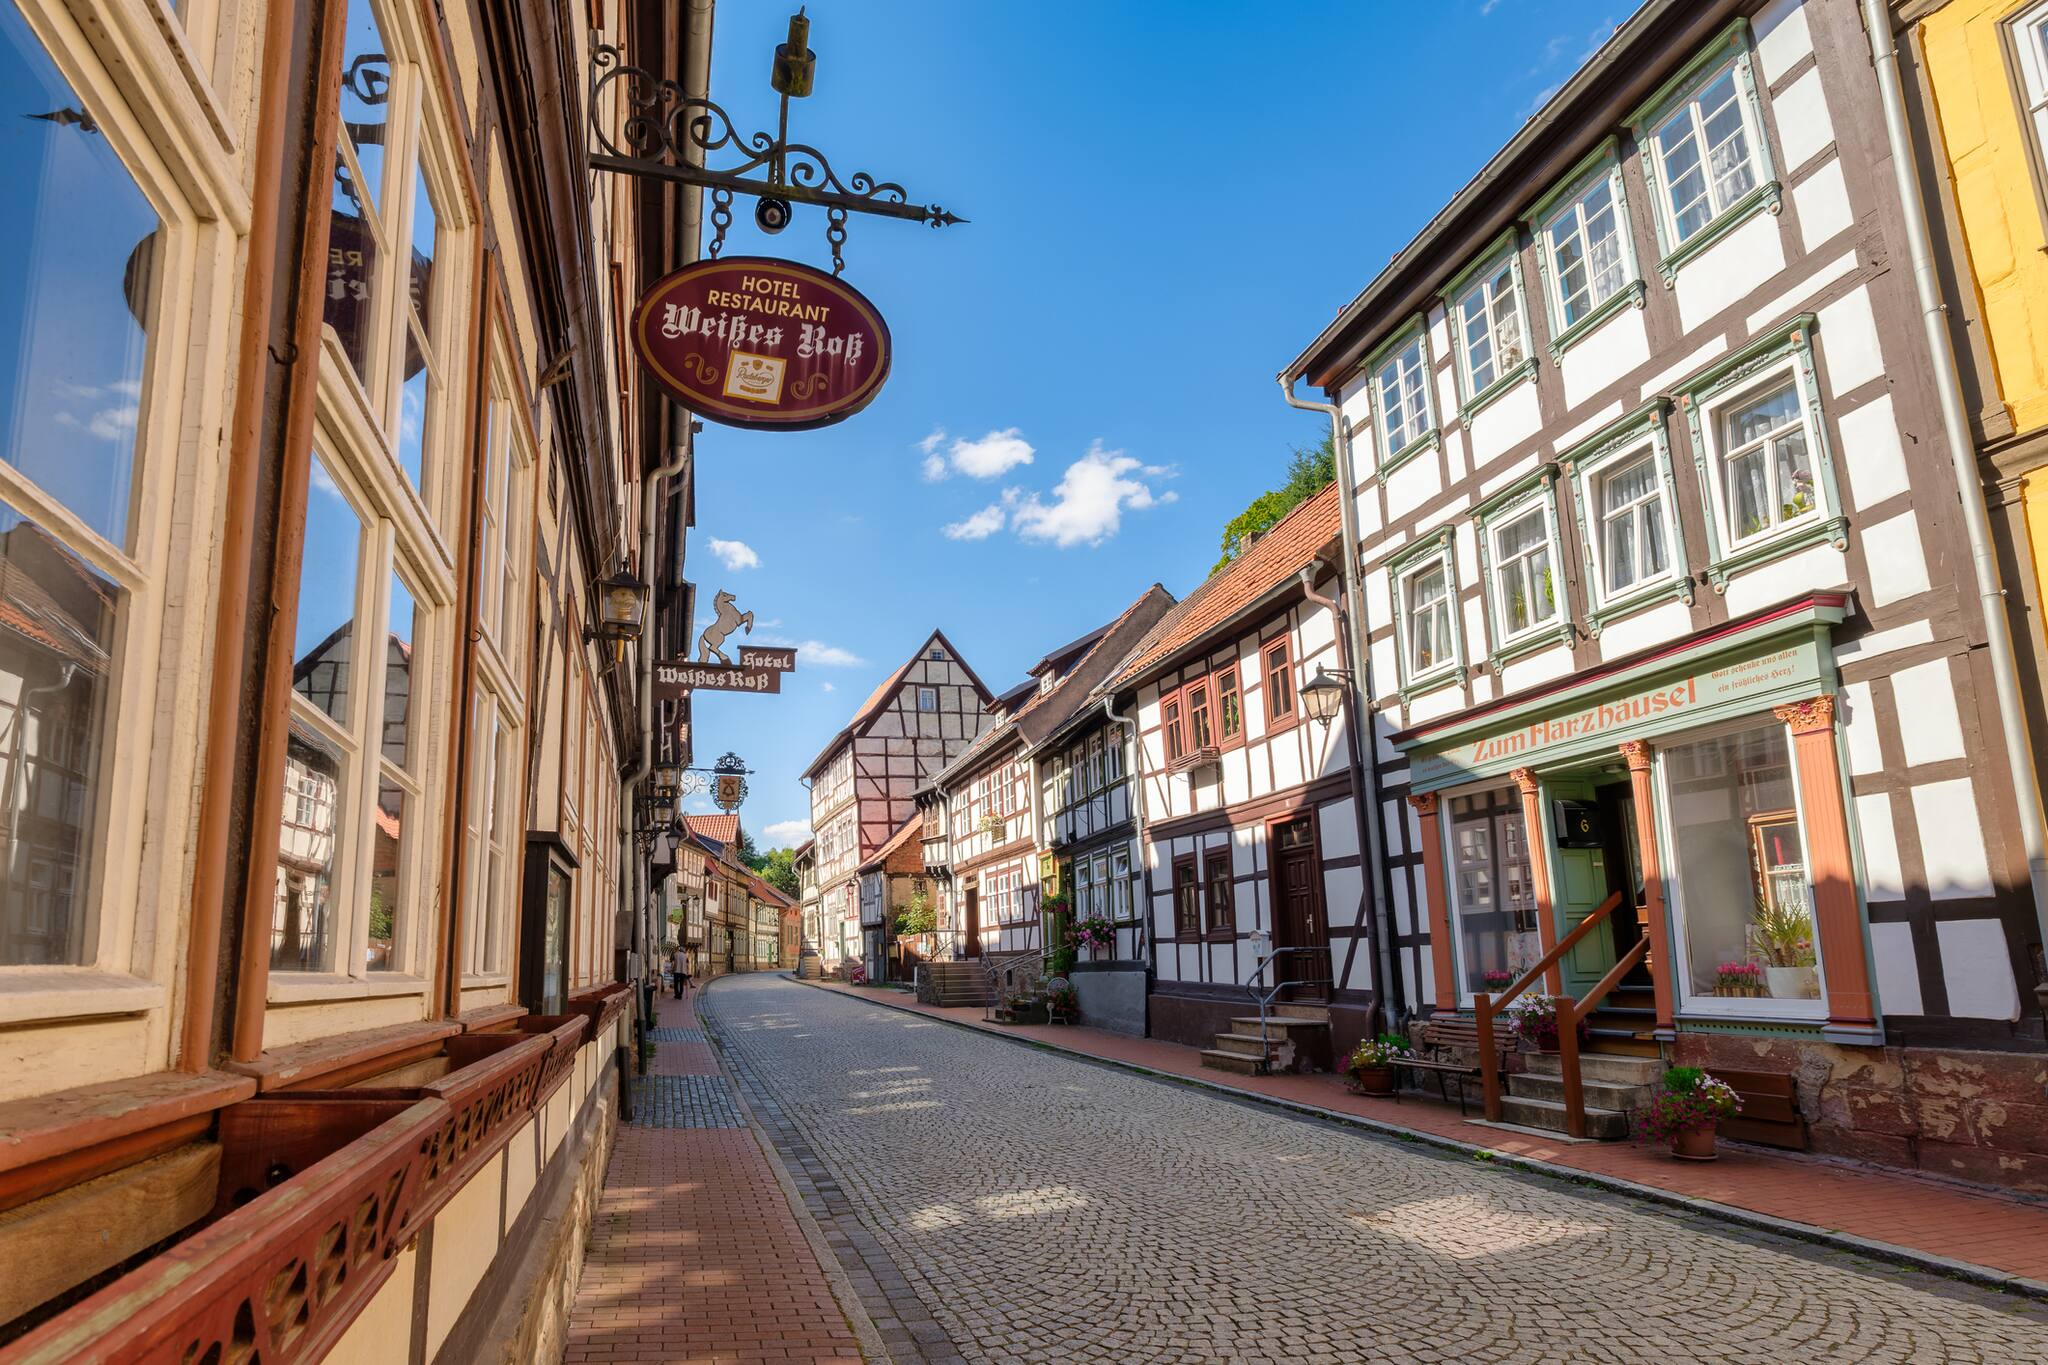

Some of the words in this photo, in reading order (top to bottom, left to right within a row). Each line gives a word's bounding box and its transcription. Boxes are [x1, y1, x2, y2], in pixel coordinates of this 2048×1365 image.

[741, 276, 801, 299] HOTEL
[707, 290, 830, 323] RESTAURANT
[661, 302, 784, 349] Weißes
[797, 323, 865, 366] Roß
[743, 652, 791, 670] Hotel
[657, 666, 726, 687] Weißes
[727, 670, 768, 691] Roß
[1472, 731, 1526, 764] Zum
[1529, 676, 1697, 748] Harzhäusel
[1580, 819, 1589, 832] 6
